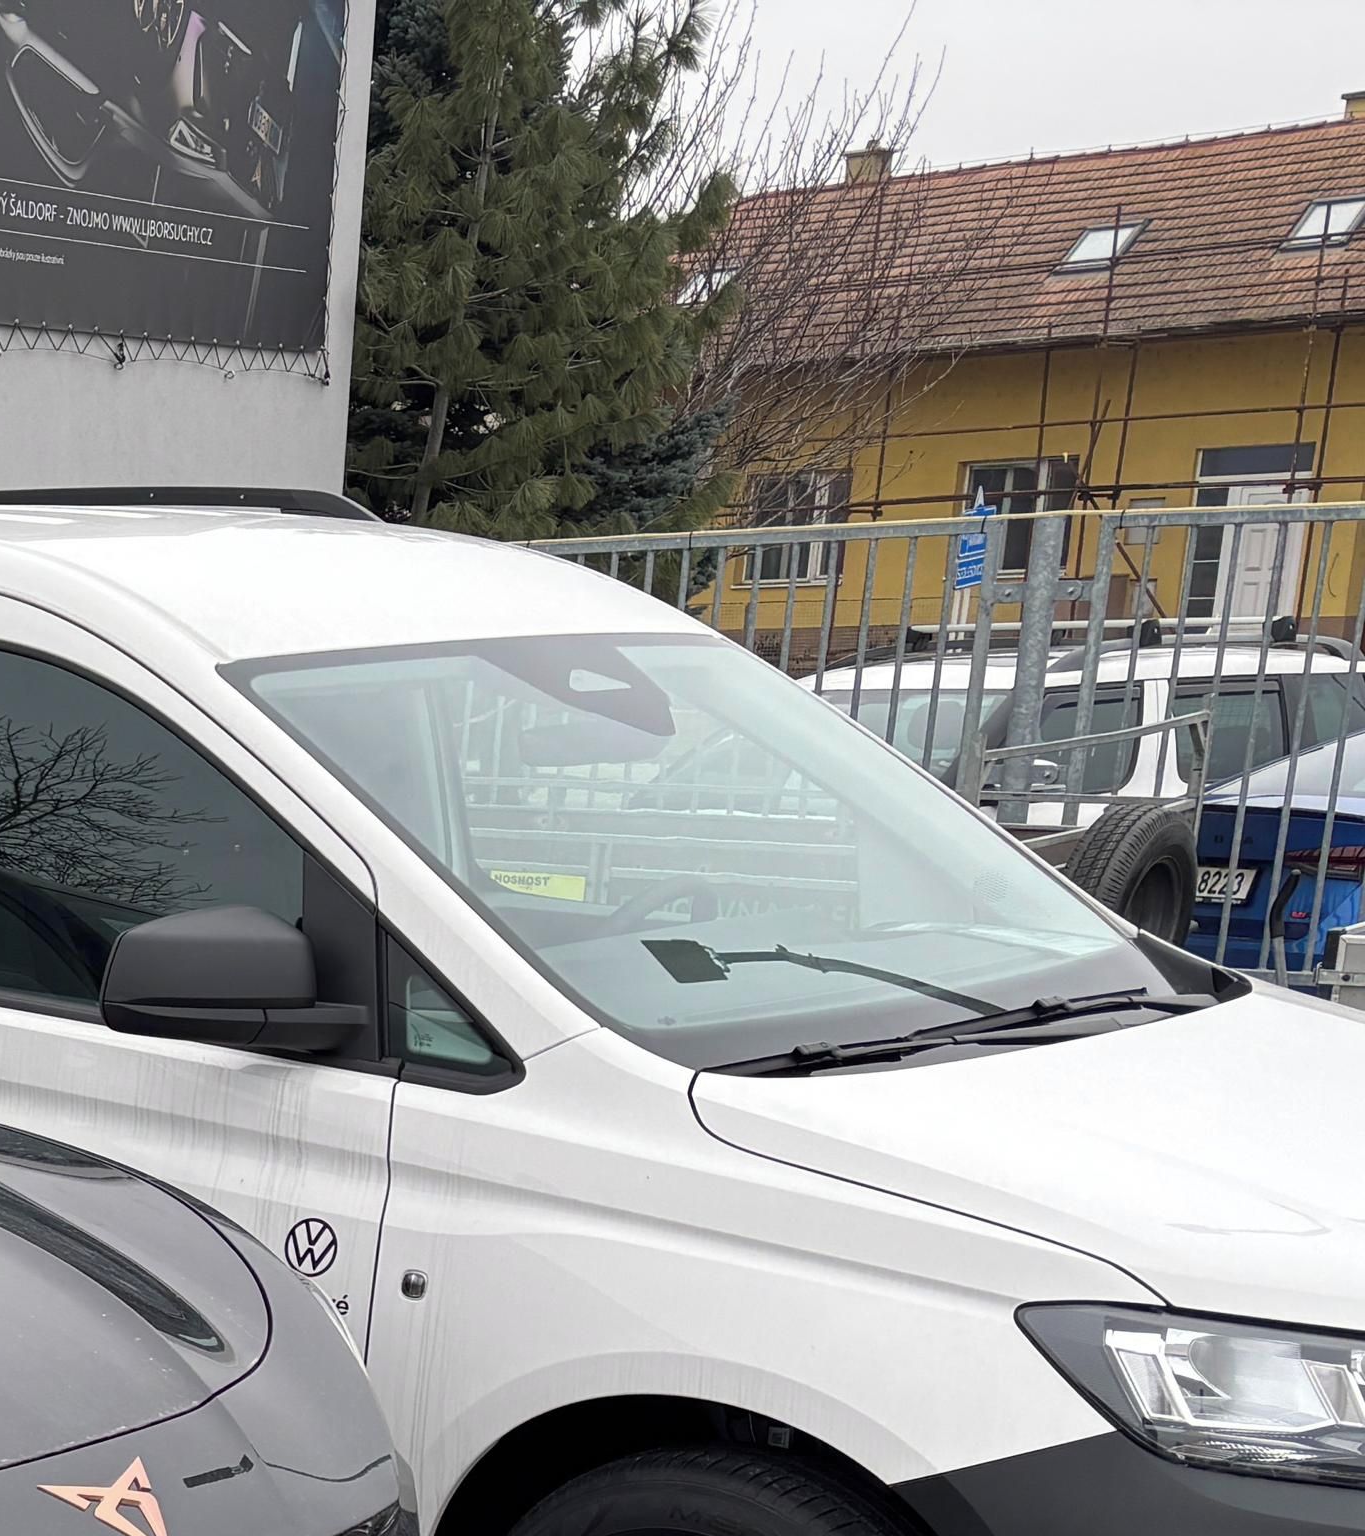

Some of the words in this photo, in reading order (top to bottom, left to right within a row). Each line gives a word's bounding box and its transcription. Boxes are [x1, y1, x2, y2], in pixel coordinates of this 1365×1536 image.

[9, 193, 58, 222] ŠALDORF
[66, 206, 110, 231] ZNOJMO
[112, 213, 214, 246] WWW.LIBORSUCHY.CZ
